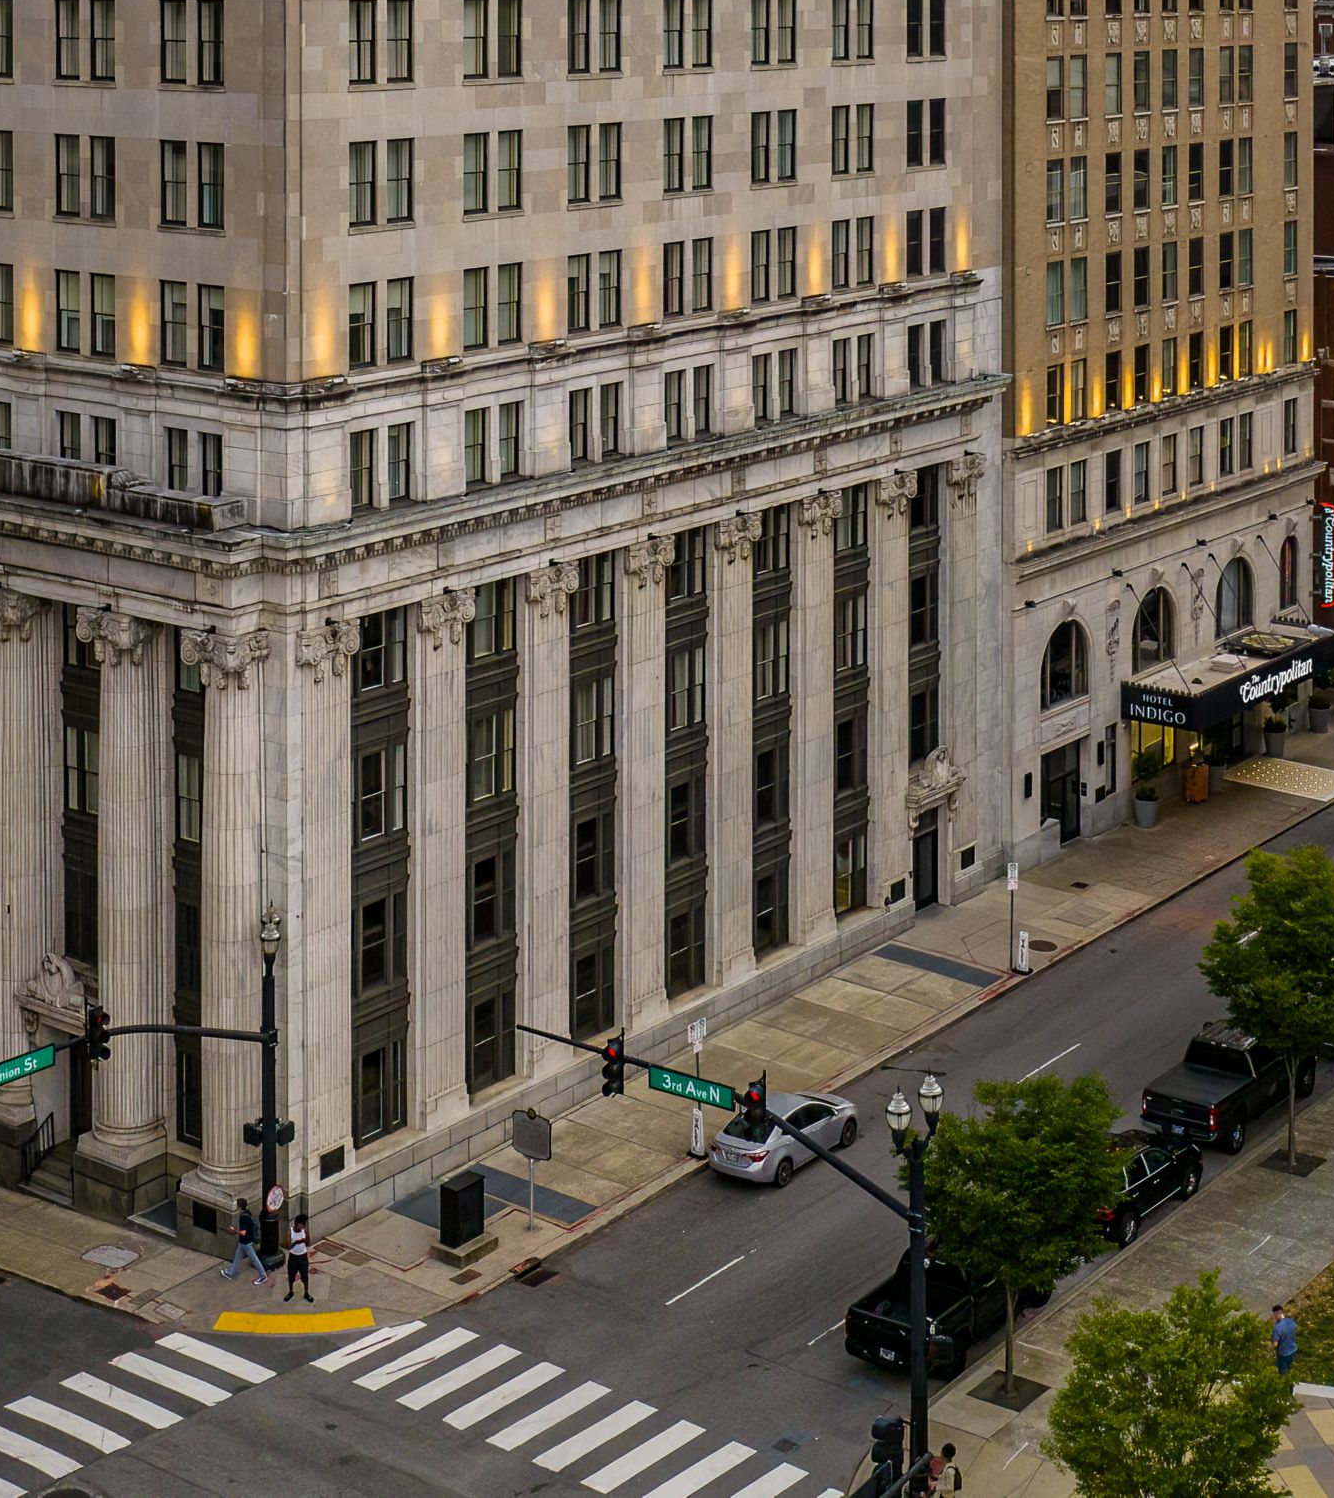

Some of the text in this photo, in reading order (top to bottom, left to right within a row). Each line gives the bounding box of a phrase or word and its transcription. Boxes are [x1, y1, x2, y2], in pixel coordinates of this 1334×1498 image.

[1239, 658, 1313, 704] Countrypolitan
[1251, 674, 1261, 684] The
[1142, 694, 1173, 707] HOTEL
[1130, 703, 1186, 725] INDIGO
[24, 1057, 38, 1072] St
[662, 1074, 720, 1103] 3rd Ave N
